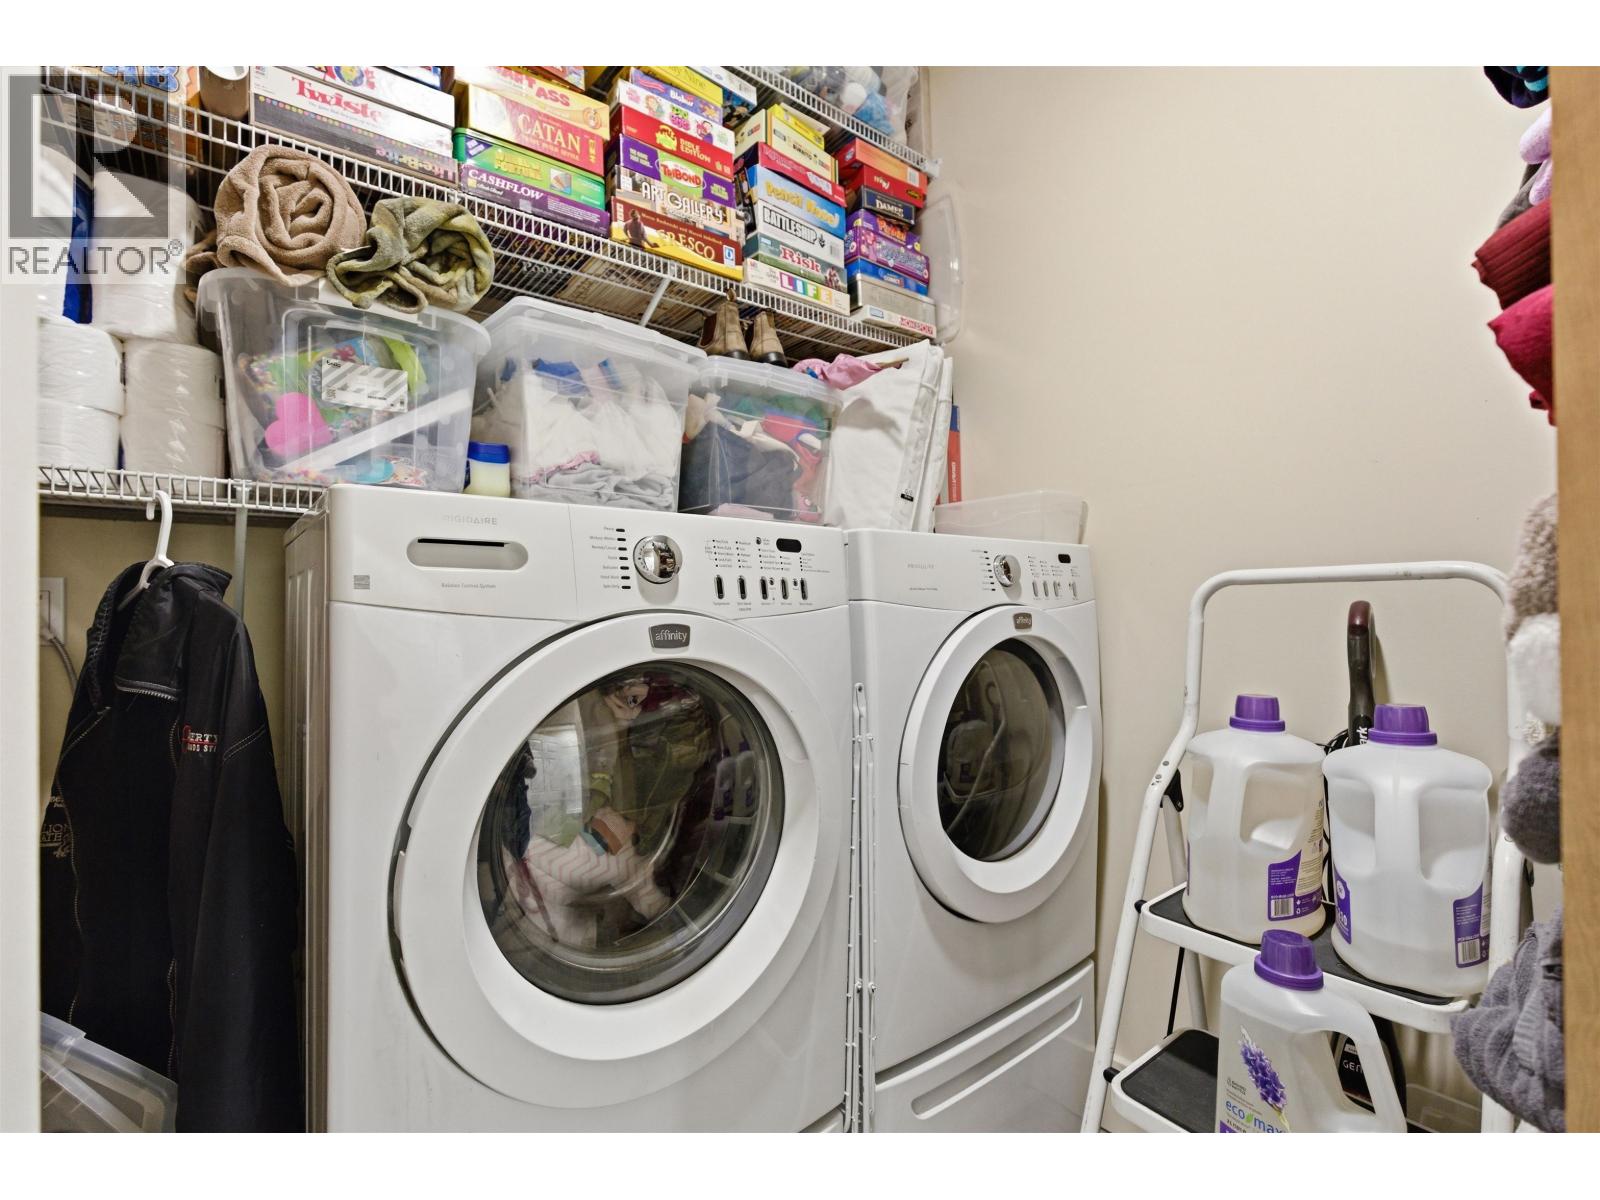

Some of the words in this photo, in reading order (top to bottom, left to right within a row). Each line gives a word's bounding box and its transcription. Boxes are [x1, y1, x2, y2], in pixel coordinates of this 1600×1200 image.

[536, 86, 570, 106] ASS
[518, 113, 582, 155] CATAN
[468, 169, 544, 200] CASHFLOW
[641, 181, 668, 201] ART
[763, 206, 818, 245] BATTLESHIP
[781, 246, 821, 273] Risk
[780, 271, 832, 304] LIFE
[655, 629, 688, 643] affinity
[1225, 1100, 1246, 1120] eco
